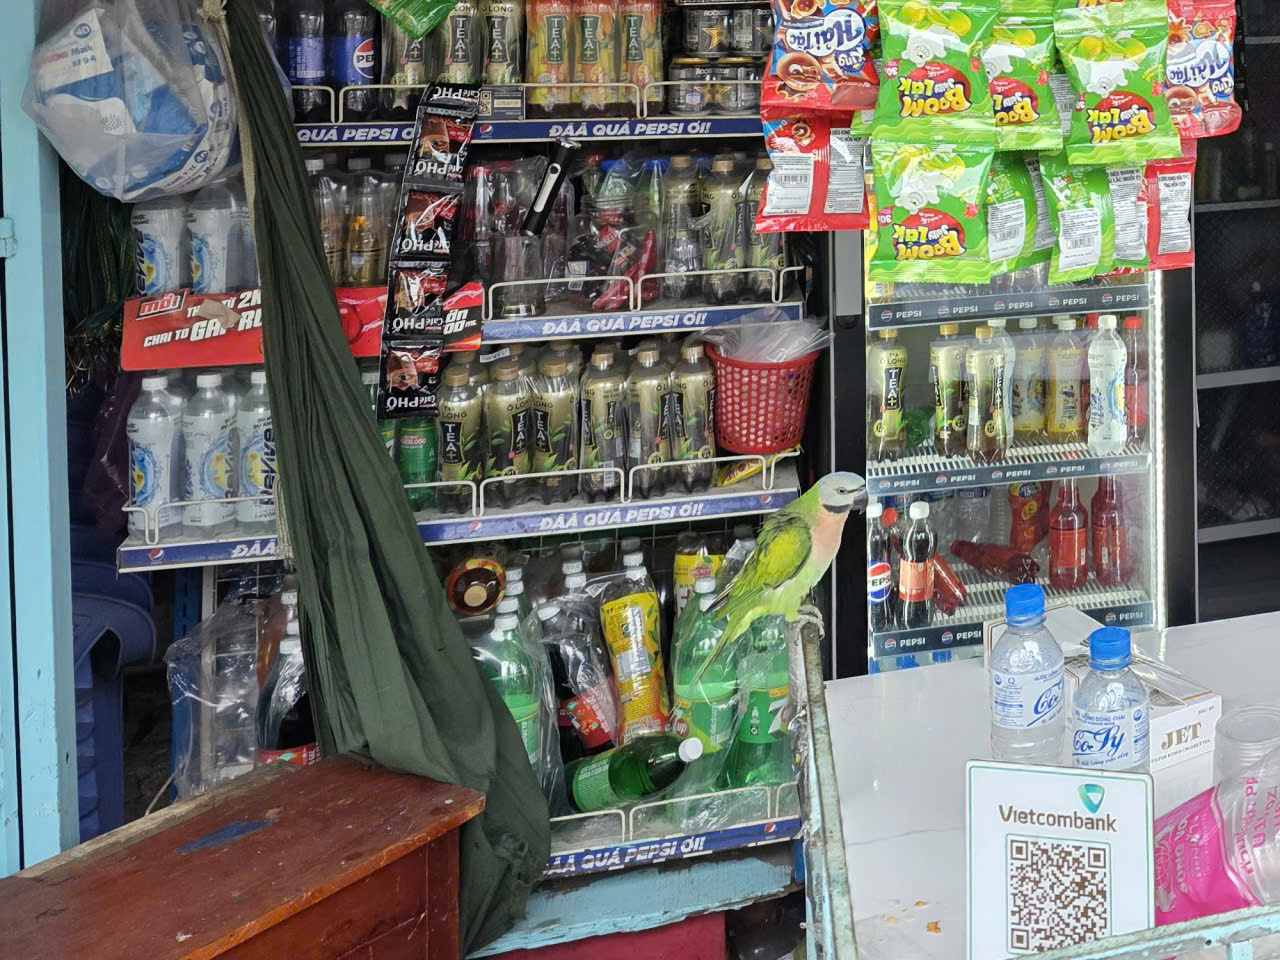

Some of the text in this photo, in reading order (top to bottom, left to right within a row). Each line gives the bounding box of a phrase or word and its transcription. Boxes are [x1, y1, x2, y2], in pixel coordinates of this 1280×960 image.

[790, 13, 864, 50] Hải Tặc
[71, 45, 94, 57] Mask
[995, 100, 1038, 126] BOO
[341, 126, 400, 141] PEPSI
[630, 122, 686, 136] PEPSI
[623, 315, 682, 331] PEPSI
[1005, 468, 1031, 478] PEPSI
[1060, 464, 1085, 474] PEPSI
[950, 473, 976, 483] PEPSI
[623, 506, 676, 522] PEPSI
[1118, 611, 1144, 622] PEPSI
[900, 636, 926, 648] PEPSI
[956, 630, 981, 641] PEPSI
[1160, 721, 1202, 751] JET
[998, 803, 1118, 833] Vietcombank
[624, 844, 680, 865] PEPSI
